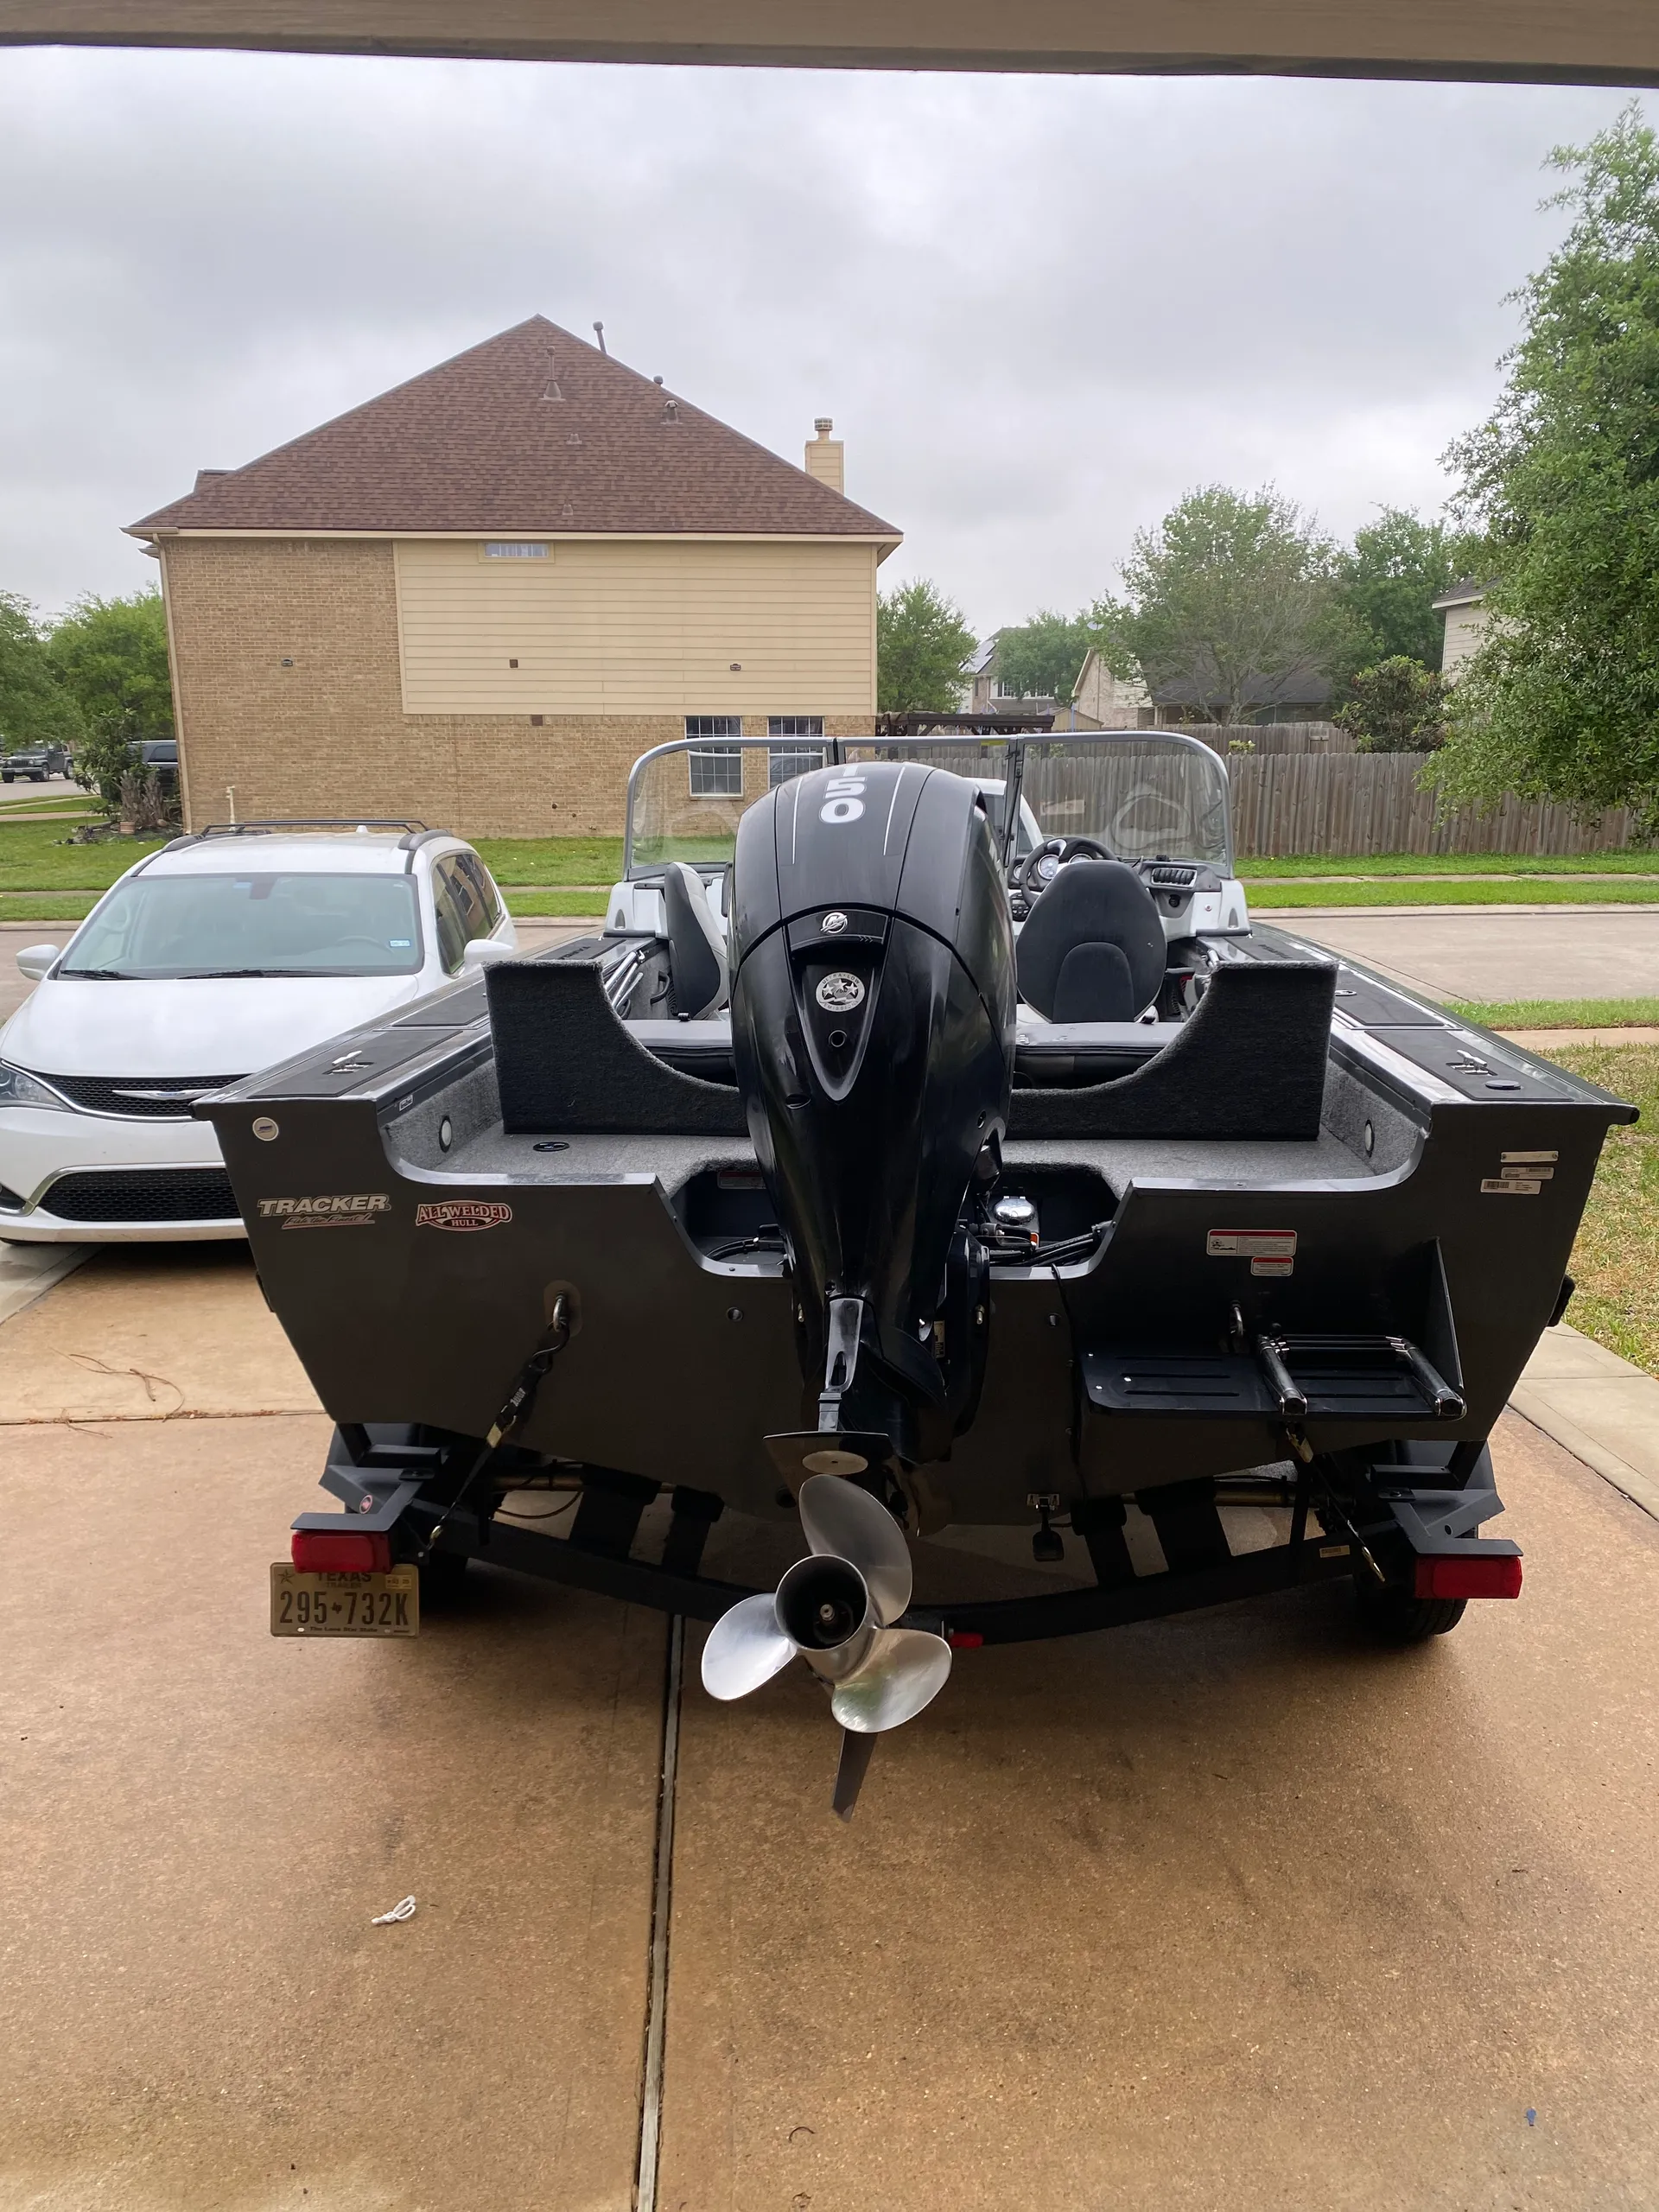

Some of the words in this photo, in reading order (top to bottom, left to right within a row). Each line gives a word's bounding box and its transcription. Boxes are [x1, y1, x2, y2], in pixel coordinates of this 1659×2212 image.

[822, 973, 842, 984] ULTRA
[847, 974, 861, 984] LOW
[259, 1194, 388, 1215] TRACKER
[418, 1205, 446, 1222] ALL
[448, 1205, 510, 1220] WELDED
